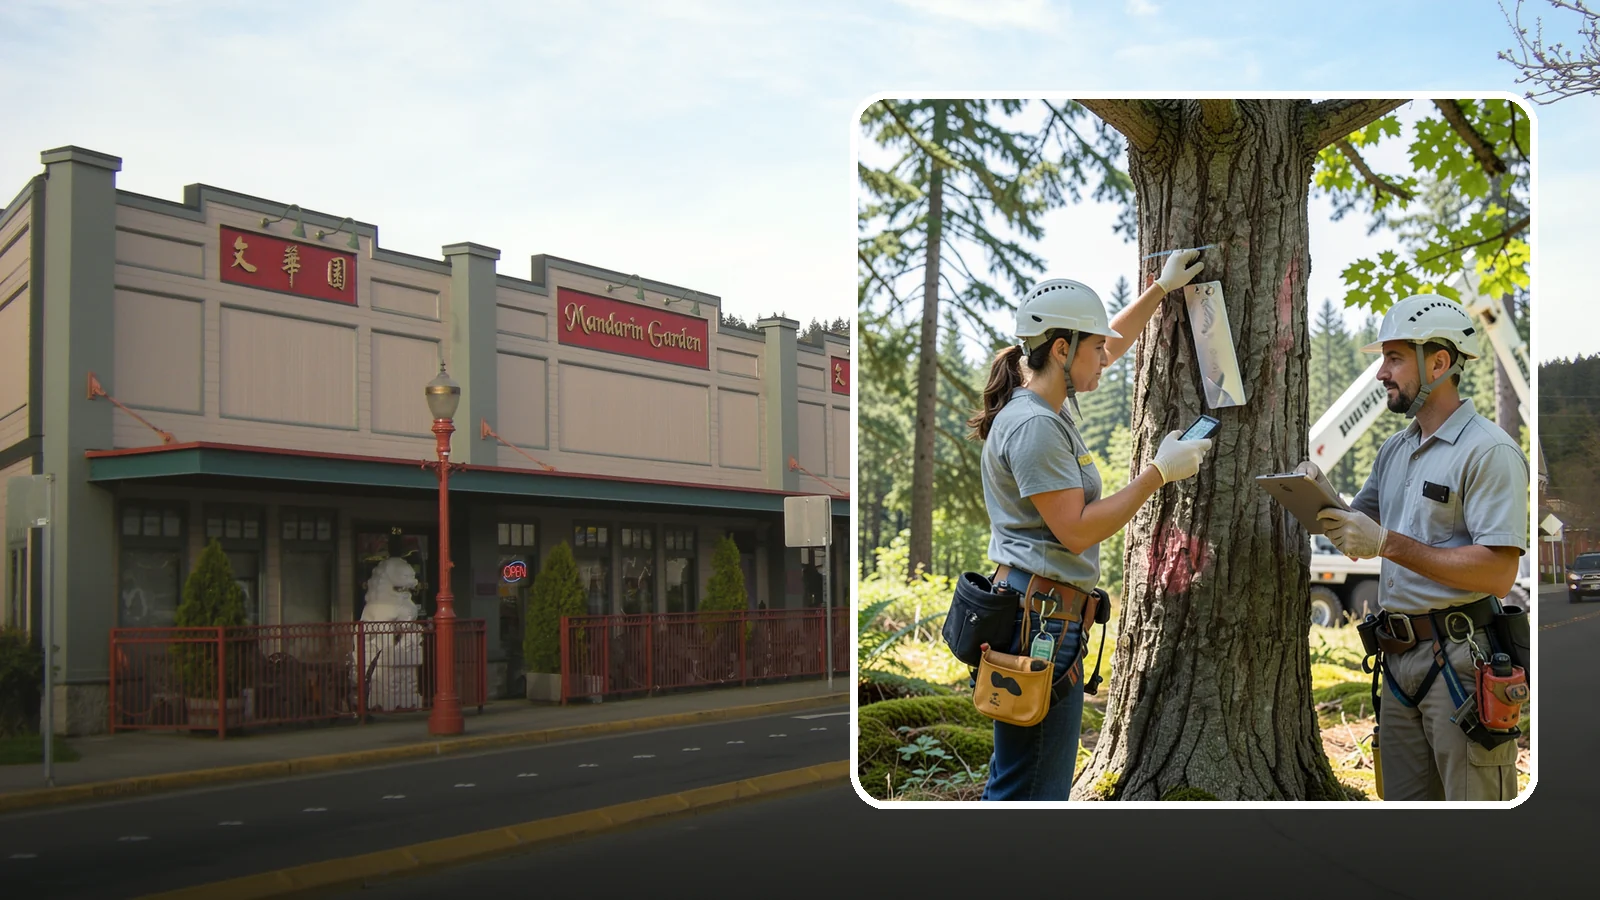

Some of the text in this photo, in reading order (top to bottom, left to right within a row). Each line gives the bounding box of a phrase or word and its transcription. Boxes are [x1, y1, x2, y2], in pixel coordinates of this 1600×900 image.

[231, 236, 346, 291] 文華園
[565, 302, 702, 352] Mandarin Garden
[504, 565, 527, 578] OPEN
